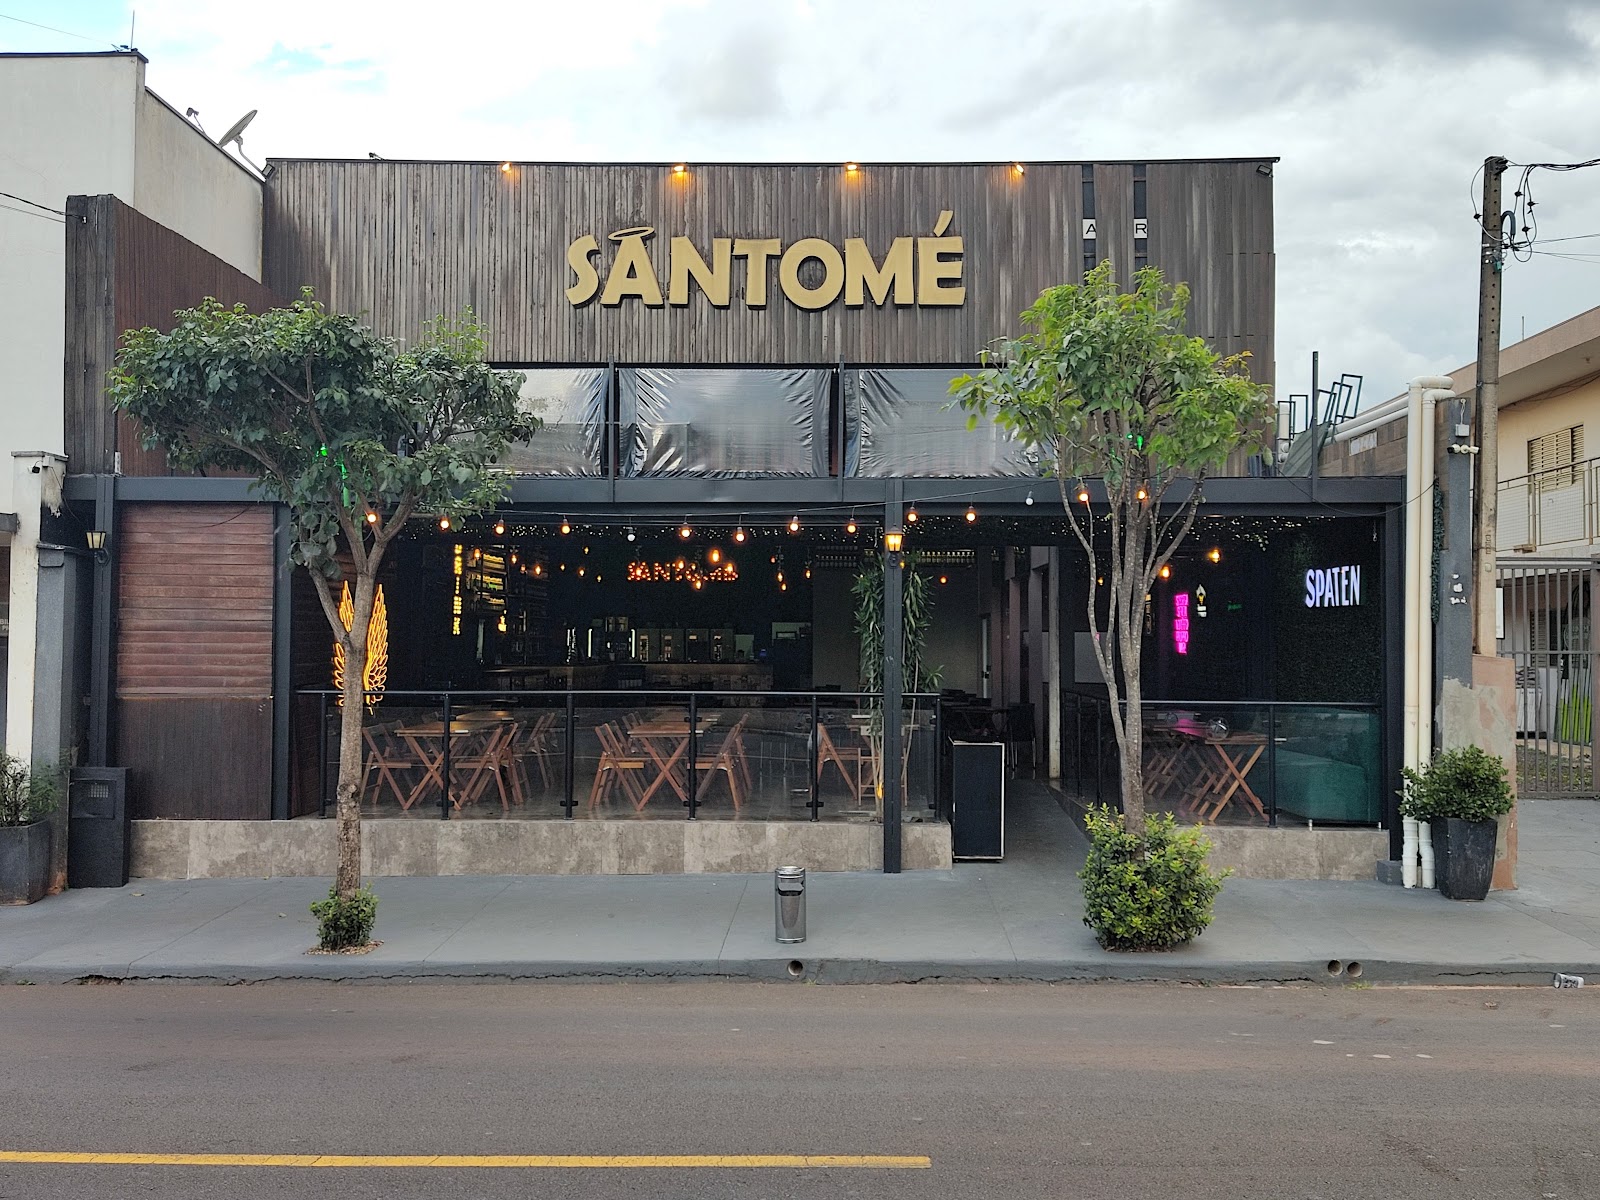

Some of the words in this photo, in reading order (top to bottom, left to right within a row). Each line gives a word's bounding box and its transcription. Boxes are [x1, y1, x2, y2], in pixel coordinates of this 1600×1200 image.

[1135, 223, 1147, 234] R
[565, 210, 966, 310] SANTOMÉ
[1305, 565, 1361, 608] SPATEN
